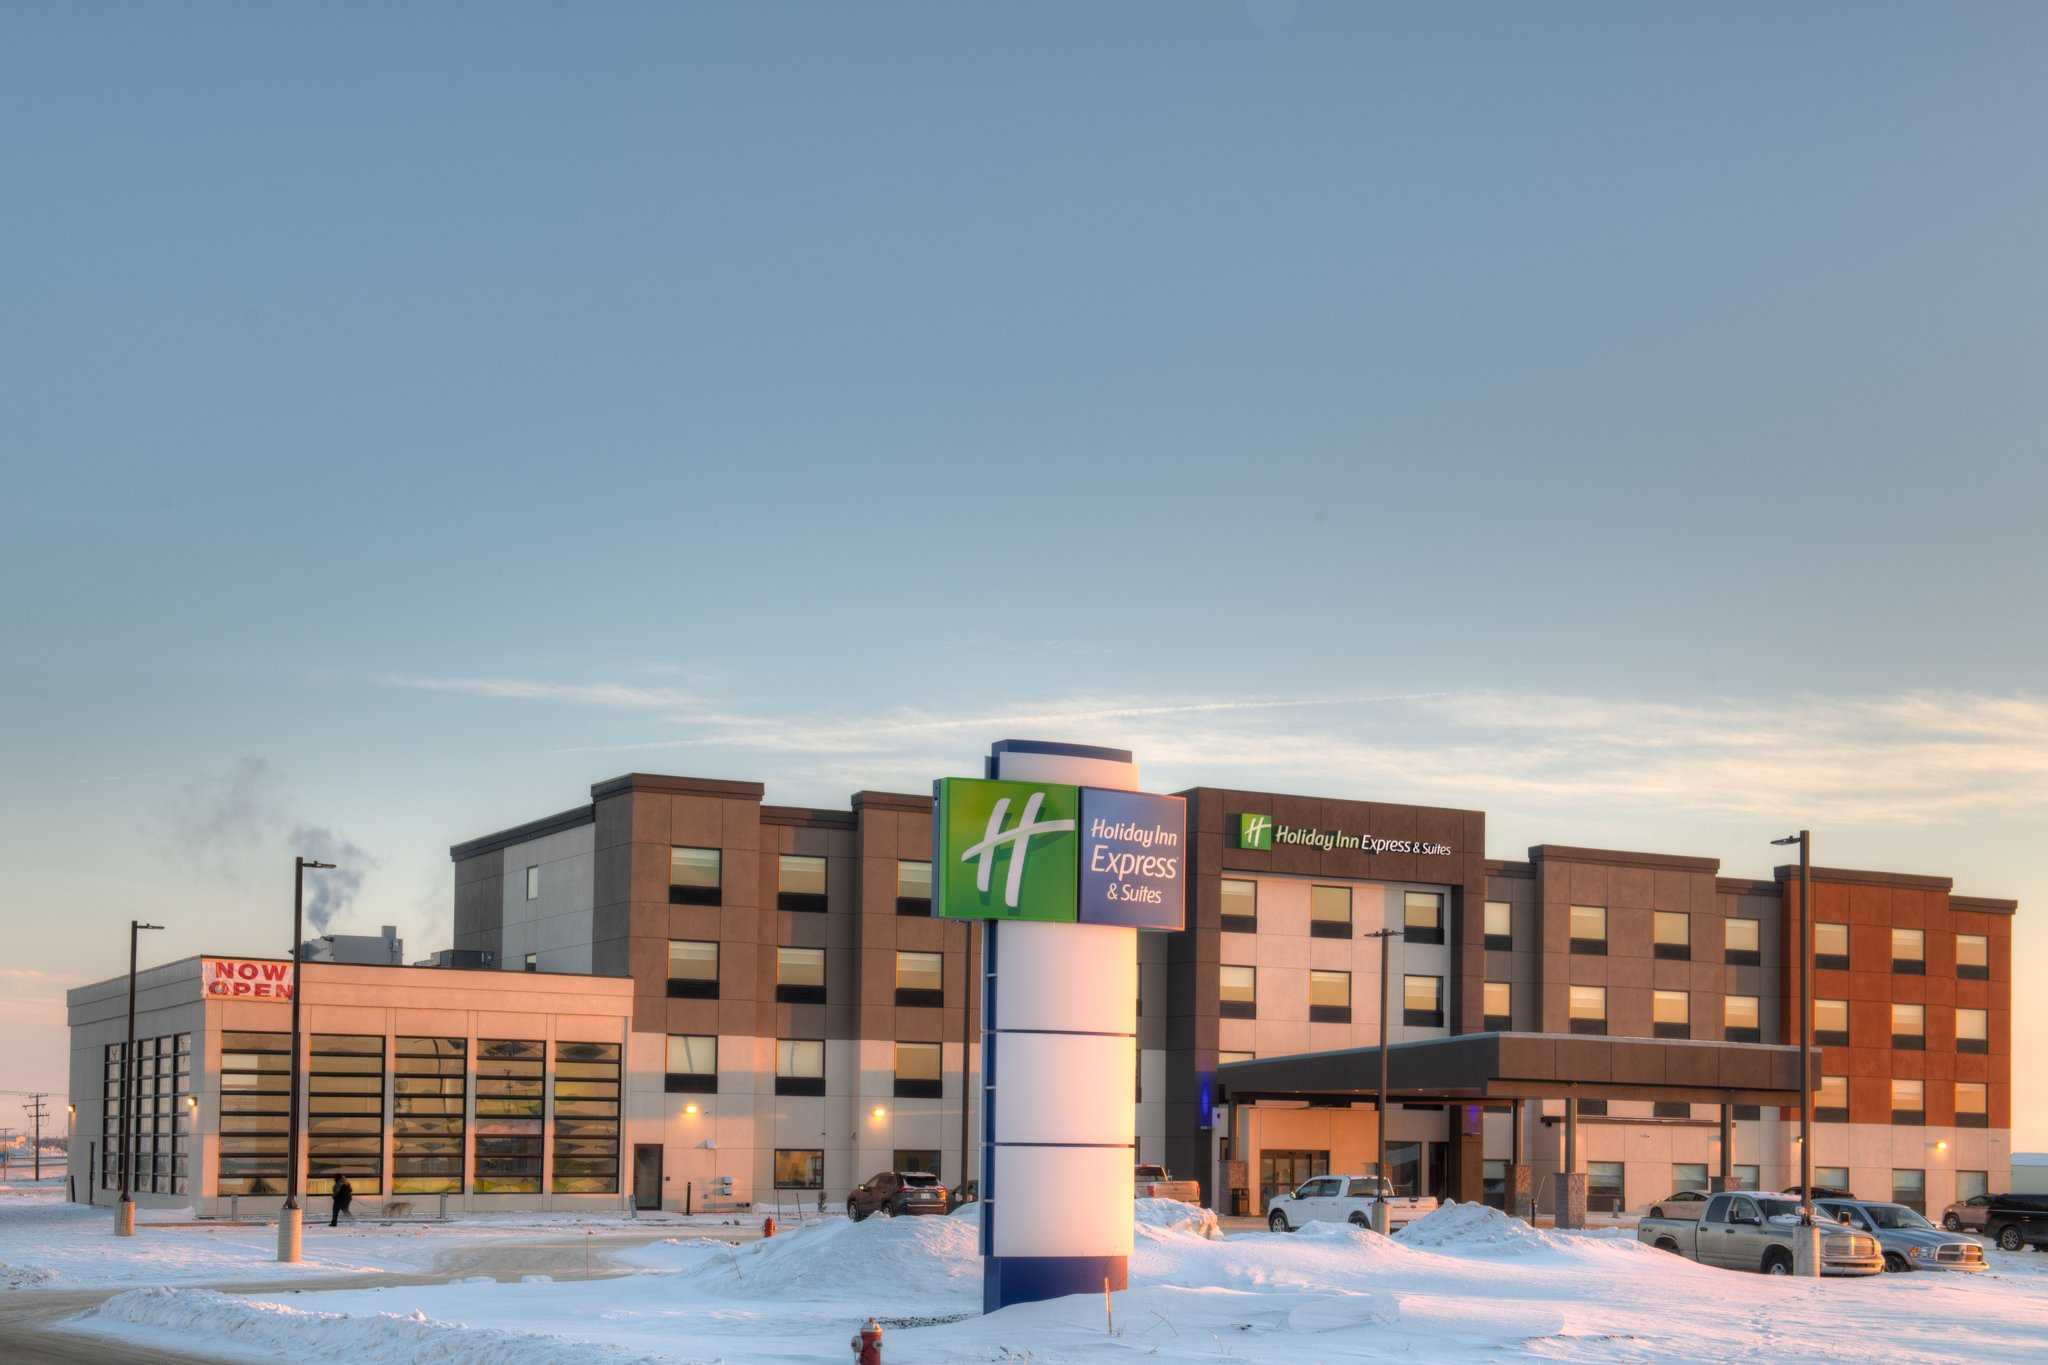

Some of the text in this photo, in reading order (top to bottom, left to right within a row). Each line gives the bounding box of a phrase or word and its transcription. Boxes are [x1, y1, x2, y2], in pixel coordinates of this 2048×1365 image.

[1091, 818, 1177, 848] Holiday Inn
[1276, 824, 1452, 856] Holiday Inn Express & Suites
[1091, 844, 1177, 882] Express
[1107, 882, 1163, 904] & Suites
[215, 961, 289, 982] NOW
[208, 980, 294, 999] OPEN
